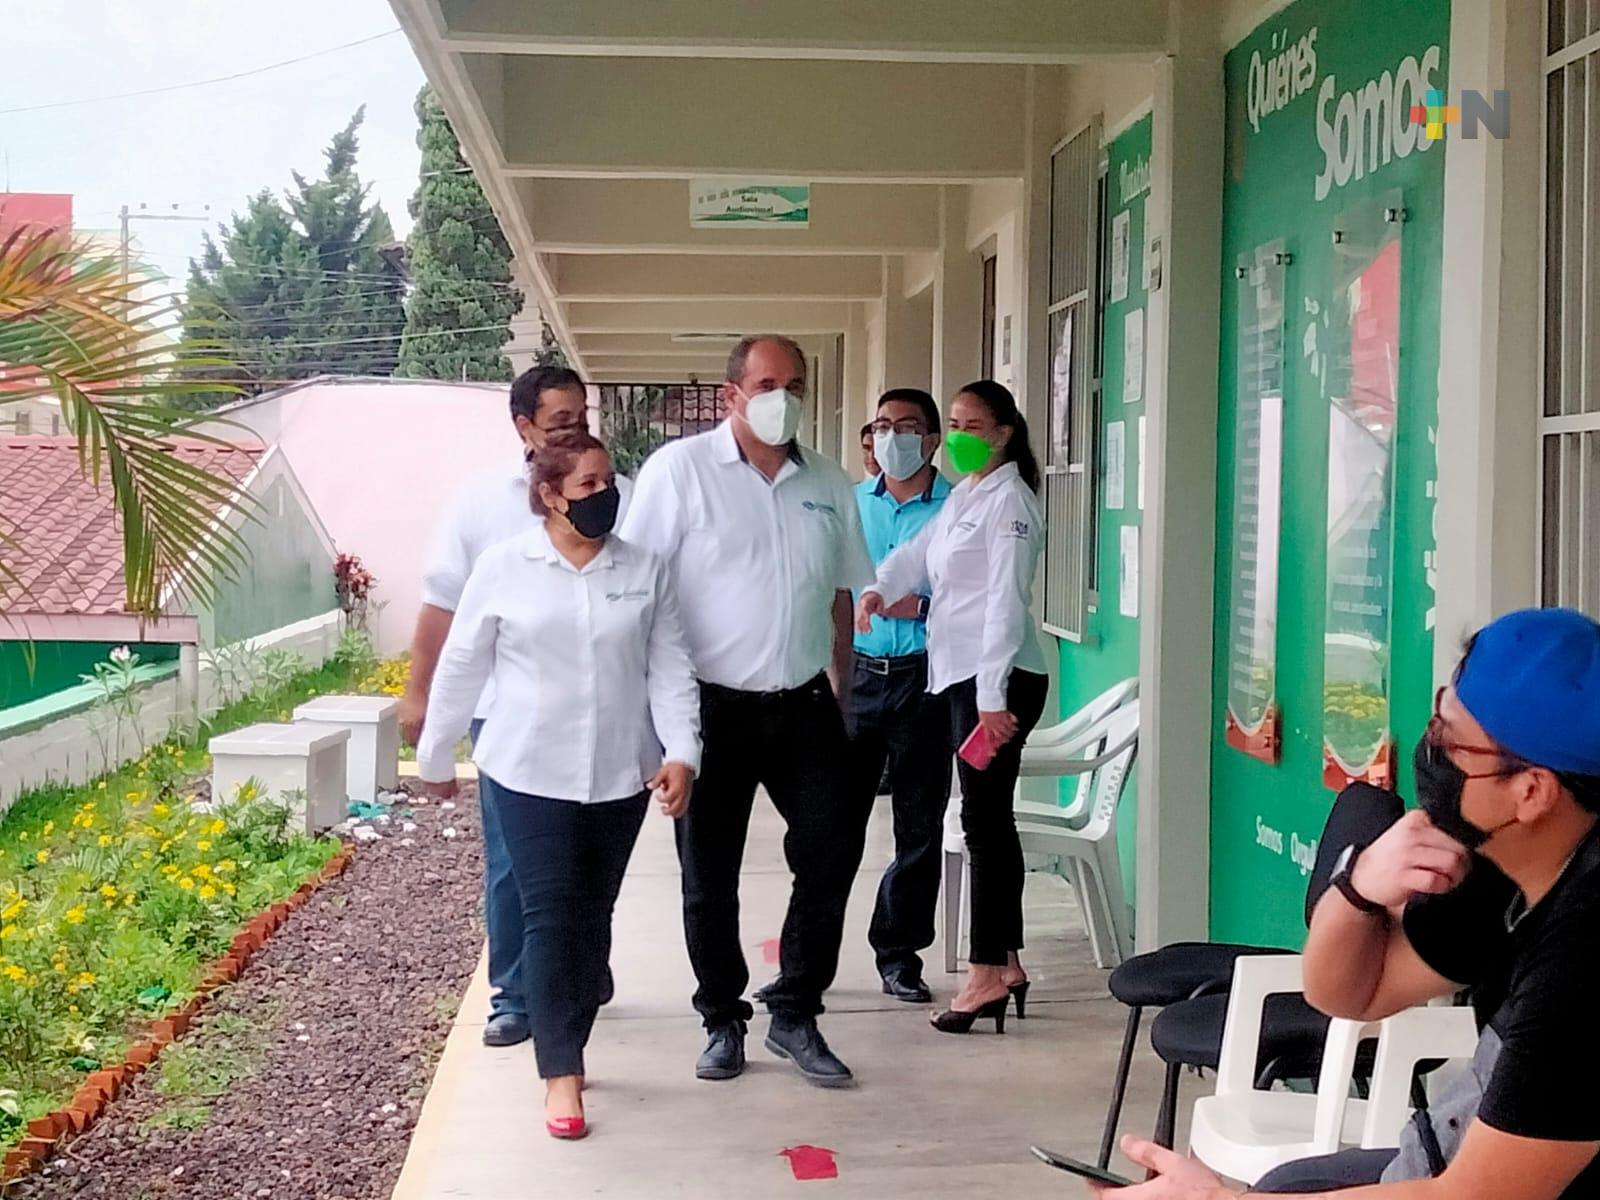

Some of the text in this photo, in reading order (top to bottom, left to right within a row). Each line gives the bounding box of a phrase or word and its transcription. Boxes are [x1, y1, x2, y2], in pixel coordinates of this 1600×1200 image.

[1247, 26, 1318, 134] Quiénes
[1315, 45, 1441, 201] Somos
[741, 195, 758, 203] Sala
